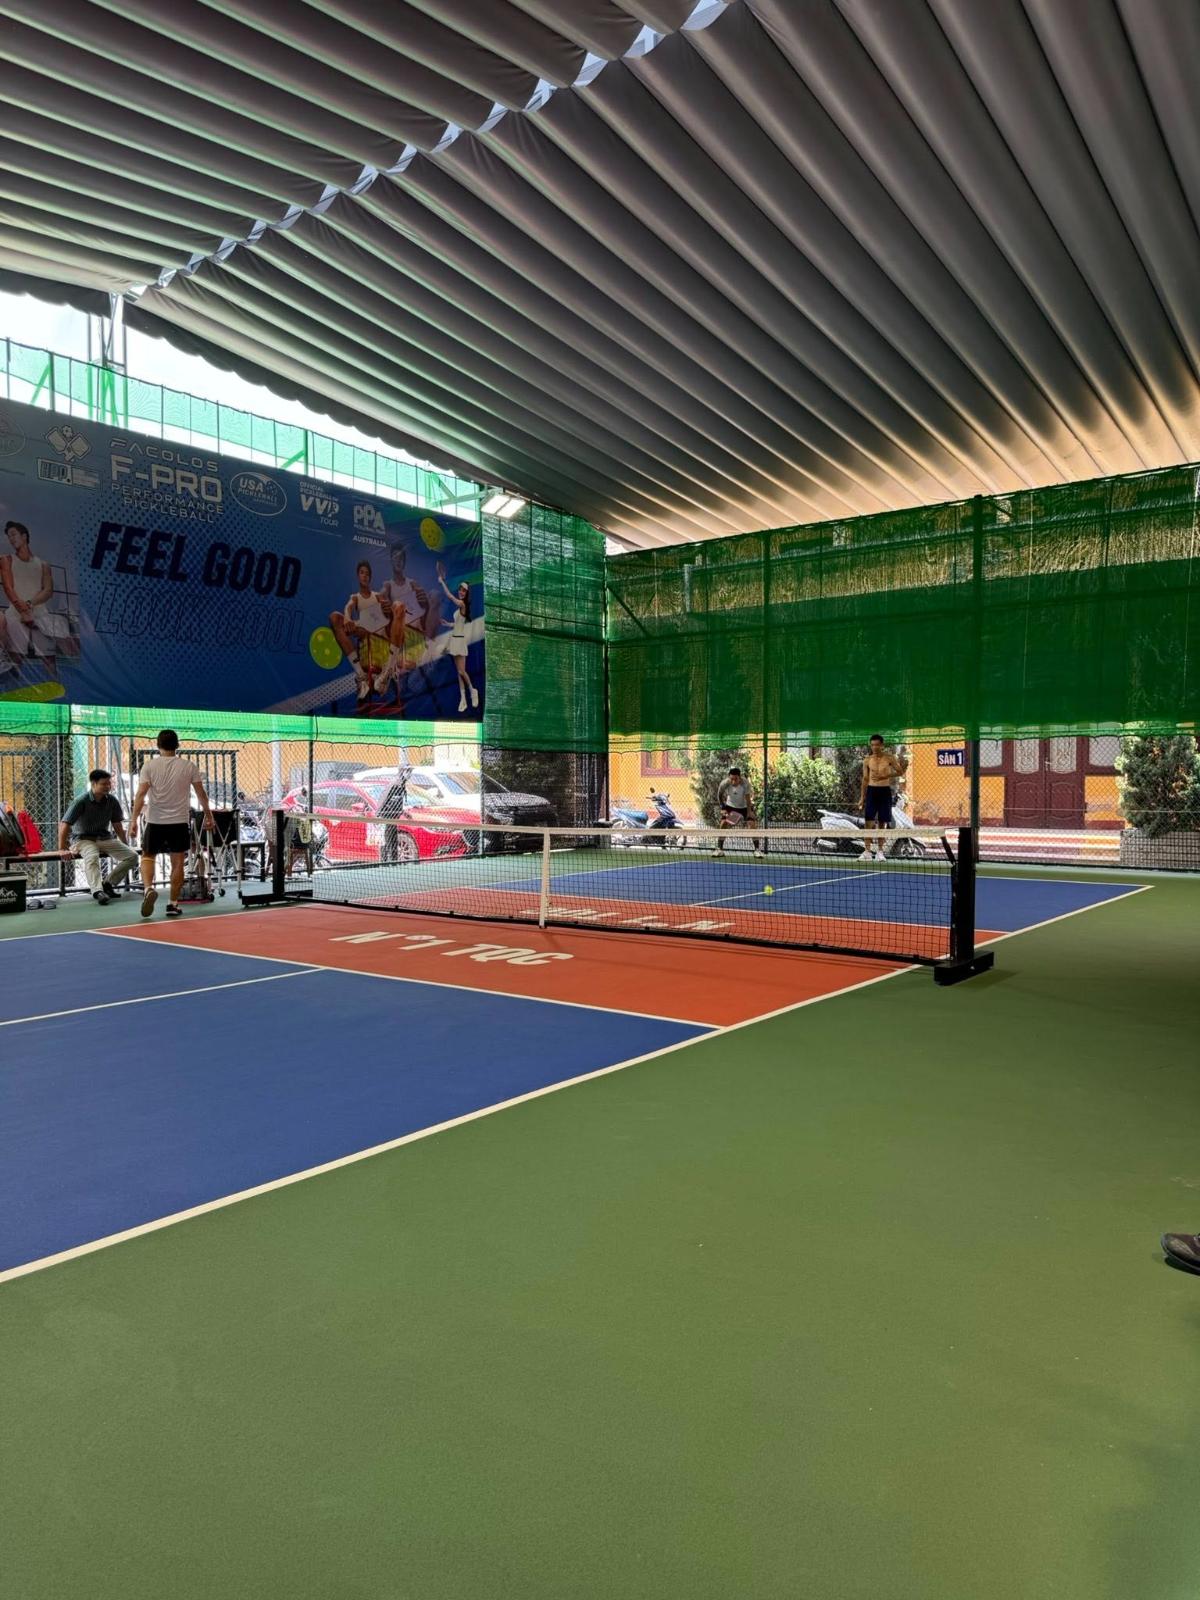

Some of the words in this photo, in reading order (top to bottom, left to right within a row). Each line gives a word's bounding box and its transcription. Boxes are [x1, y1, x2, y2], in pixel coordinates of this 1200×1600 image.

[110, 437, 219, 473] FACOLOS
[111, 454, 223, 503] F-PRO
[239, 477, 264, 493] USA
[111, 484, 224, 515] PERFORMANCE
[124, 498, 215, 524] PICKLEBALL
[320, 516, 340, 527] TOUR
[353, 504, 386, 530] PPA
[352, 534, 387, 548] AUSTRALIA
[90, 521, 190, 583] FEEL
[203, 541, 302, 599] GOOD
[95, 582, 207, 644] LOOK
[957, 751, 963, 765] 1
[440, 943, 574, 965] TQC
